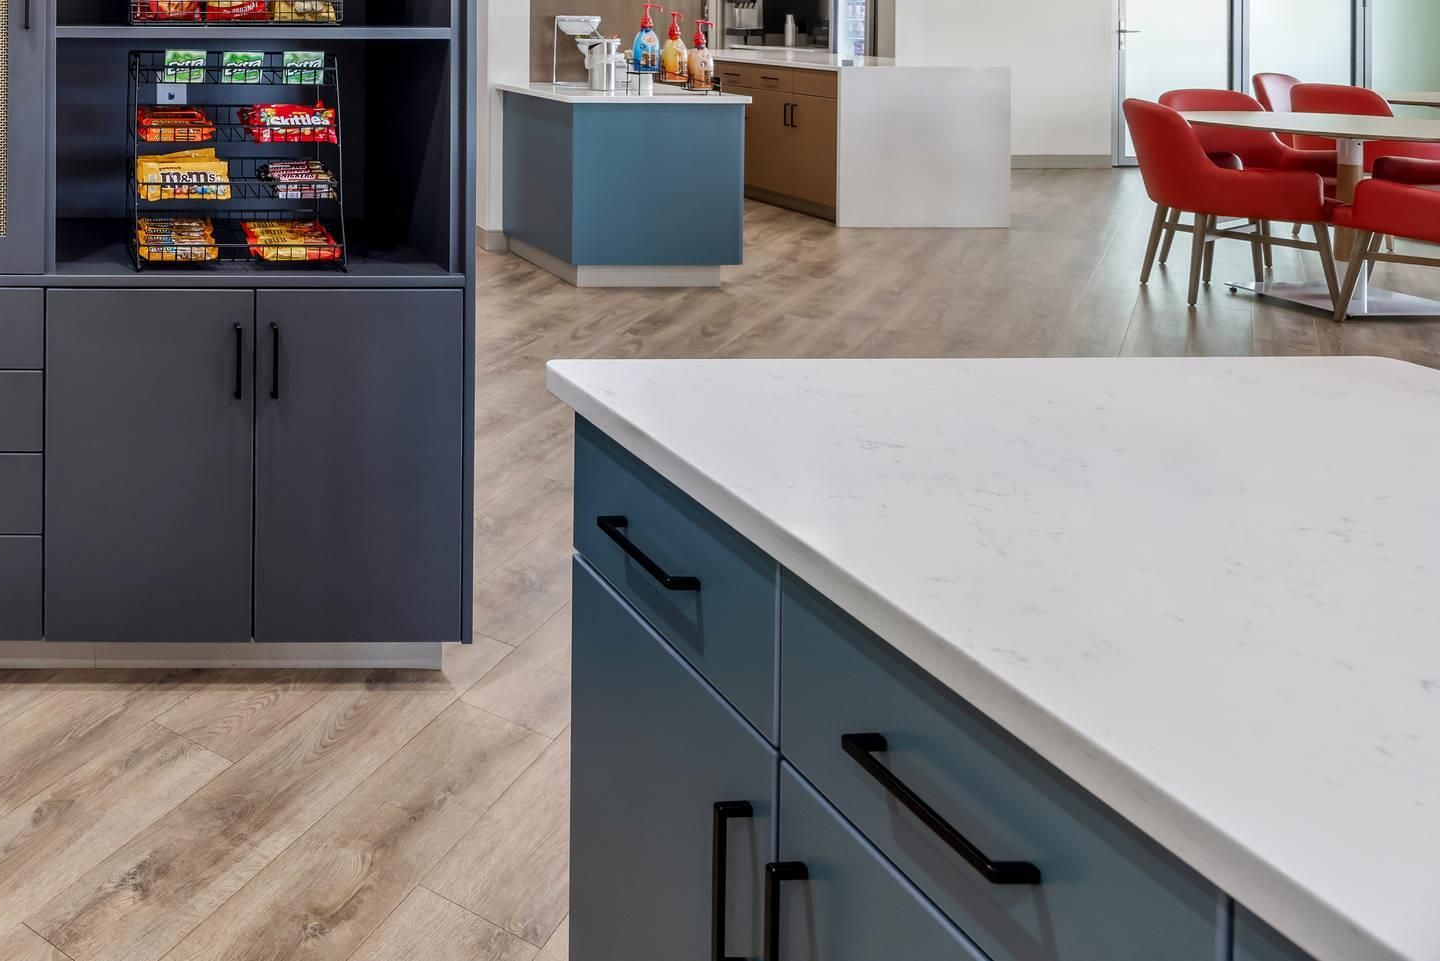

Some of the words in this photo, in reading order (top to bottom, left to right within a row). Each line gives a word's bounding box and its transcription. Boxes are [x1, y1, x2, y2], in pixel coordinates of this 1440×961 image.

[166, 58, 205, 76] Extra
[224, 59, 263, 76] Extra
[286, 59, 322, 76] Extra
[270, 113, 330, 126] Skittles
